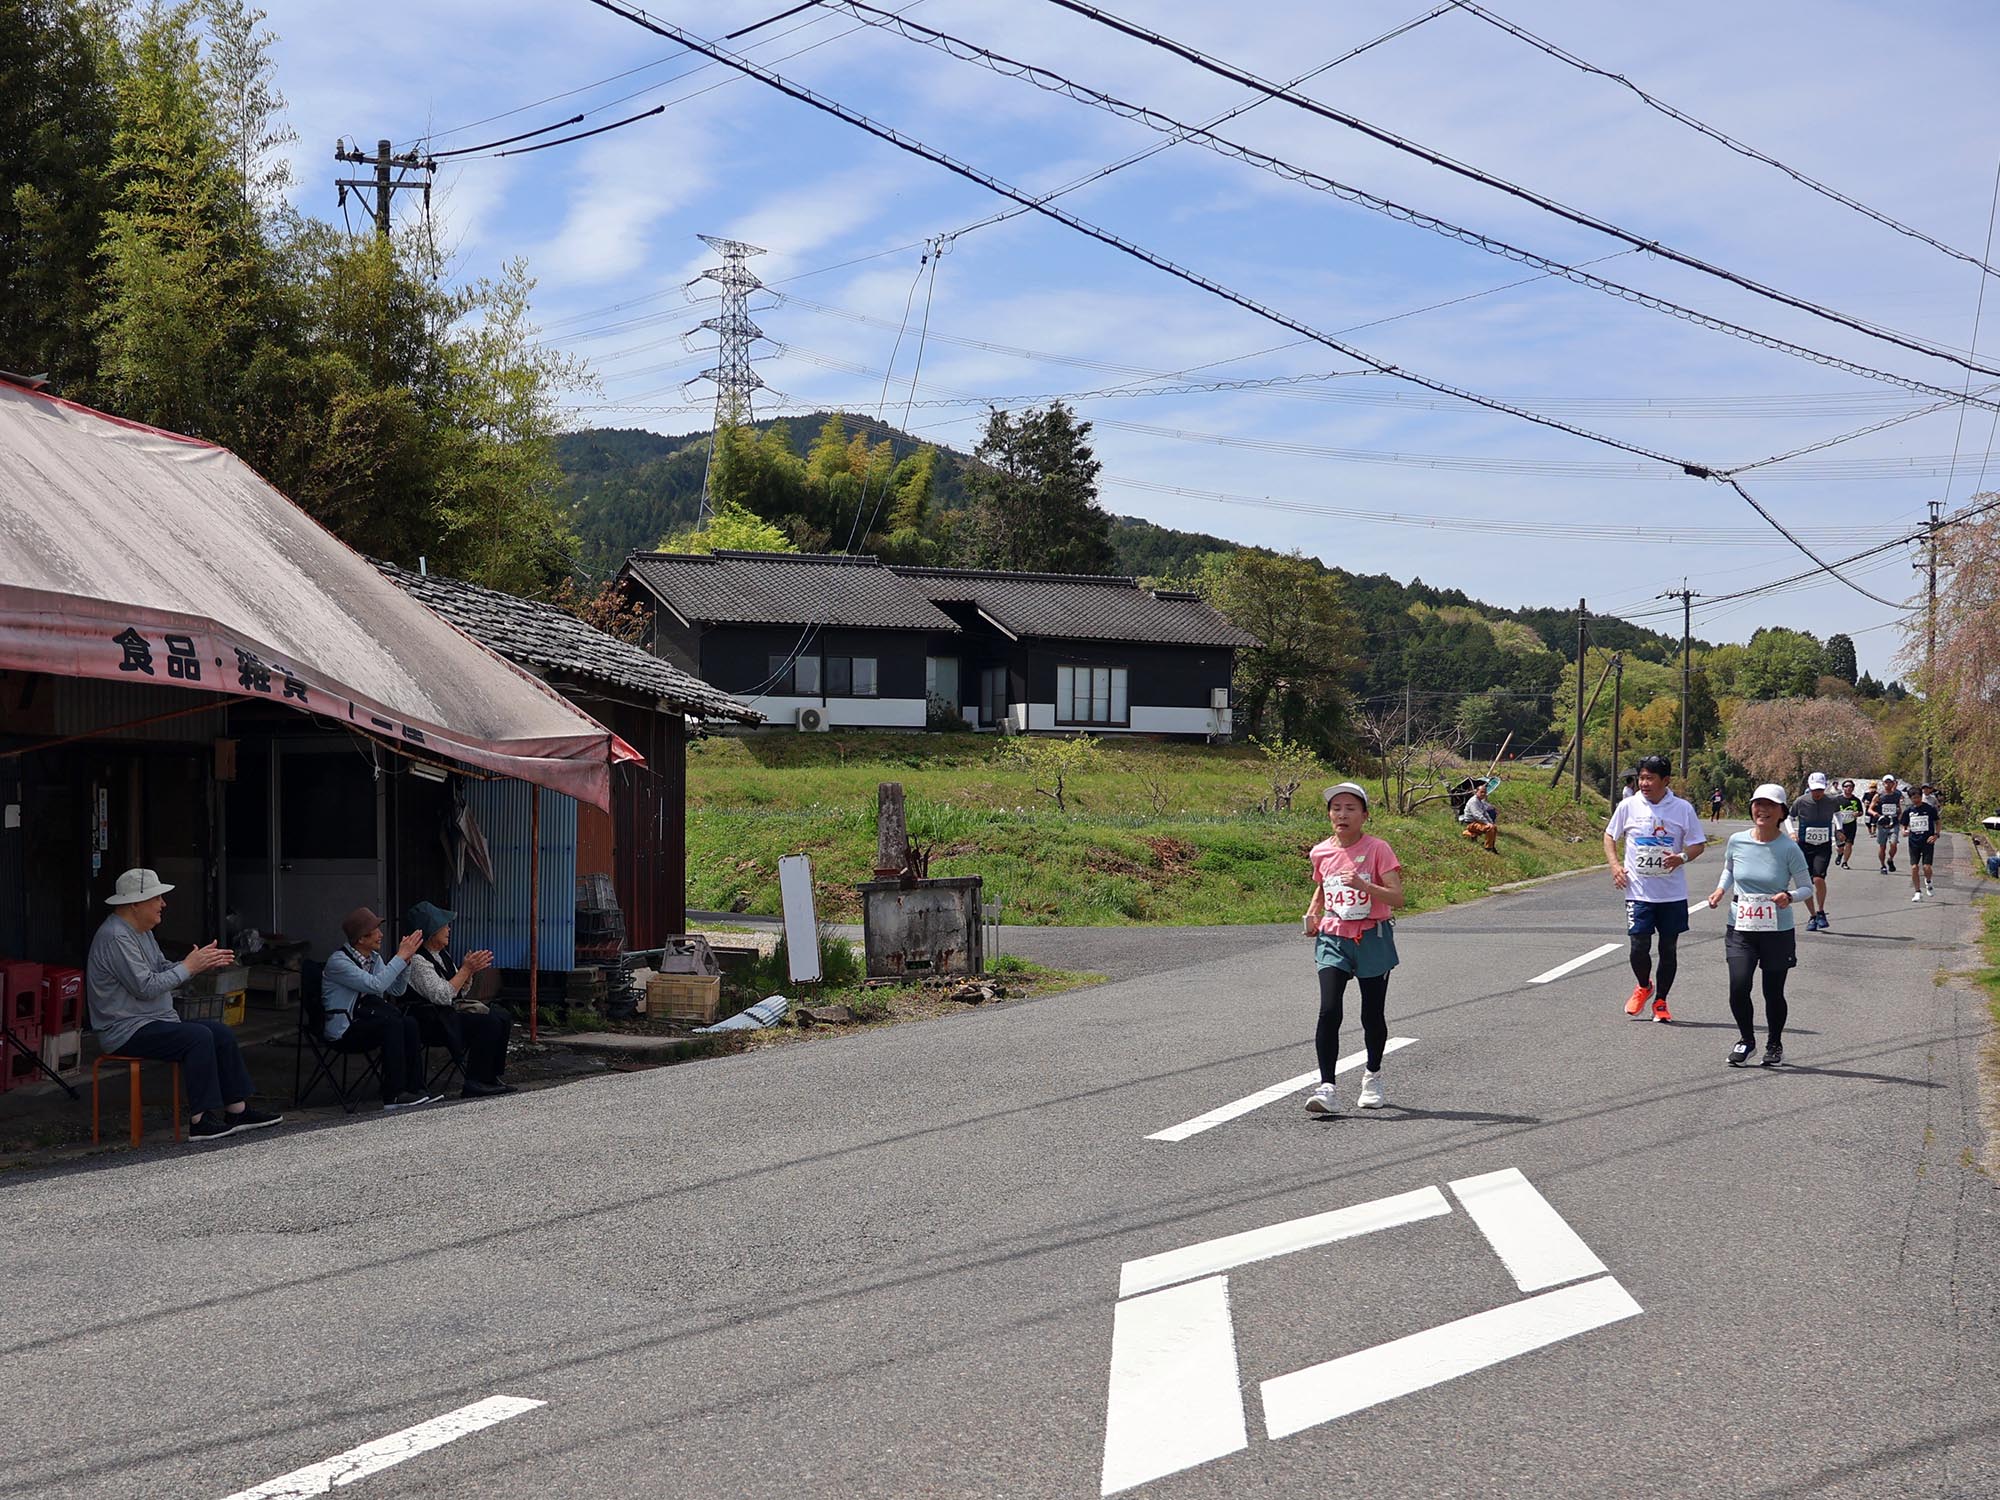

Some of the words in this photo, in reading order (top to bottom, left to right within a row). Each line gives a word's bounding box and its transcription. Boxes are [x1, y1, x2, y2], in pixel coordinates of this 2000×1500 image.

[1806, 832, 1827, 841] 2031
[1637, 856, 1662, 868] 244
[1325, 889, 1369, 908] 3439
[1738, 905, 1772, 920] 3441
